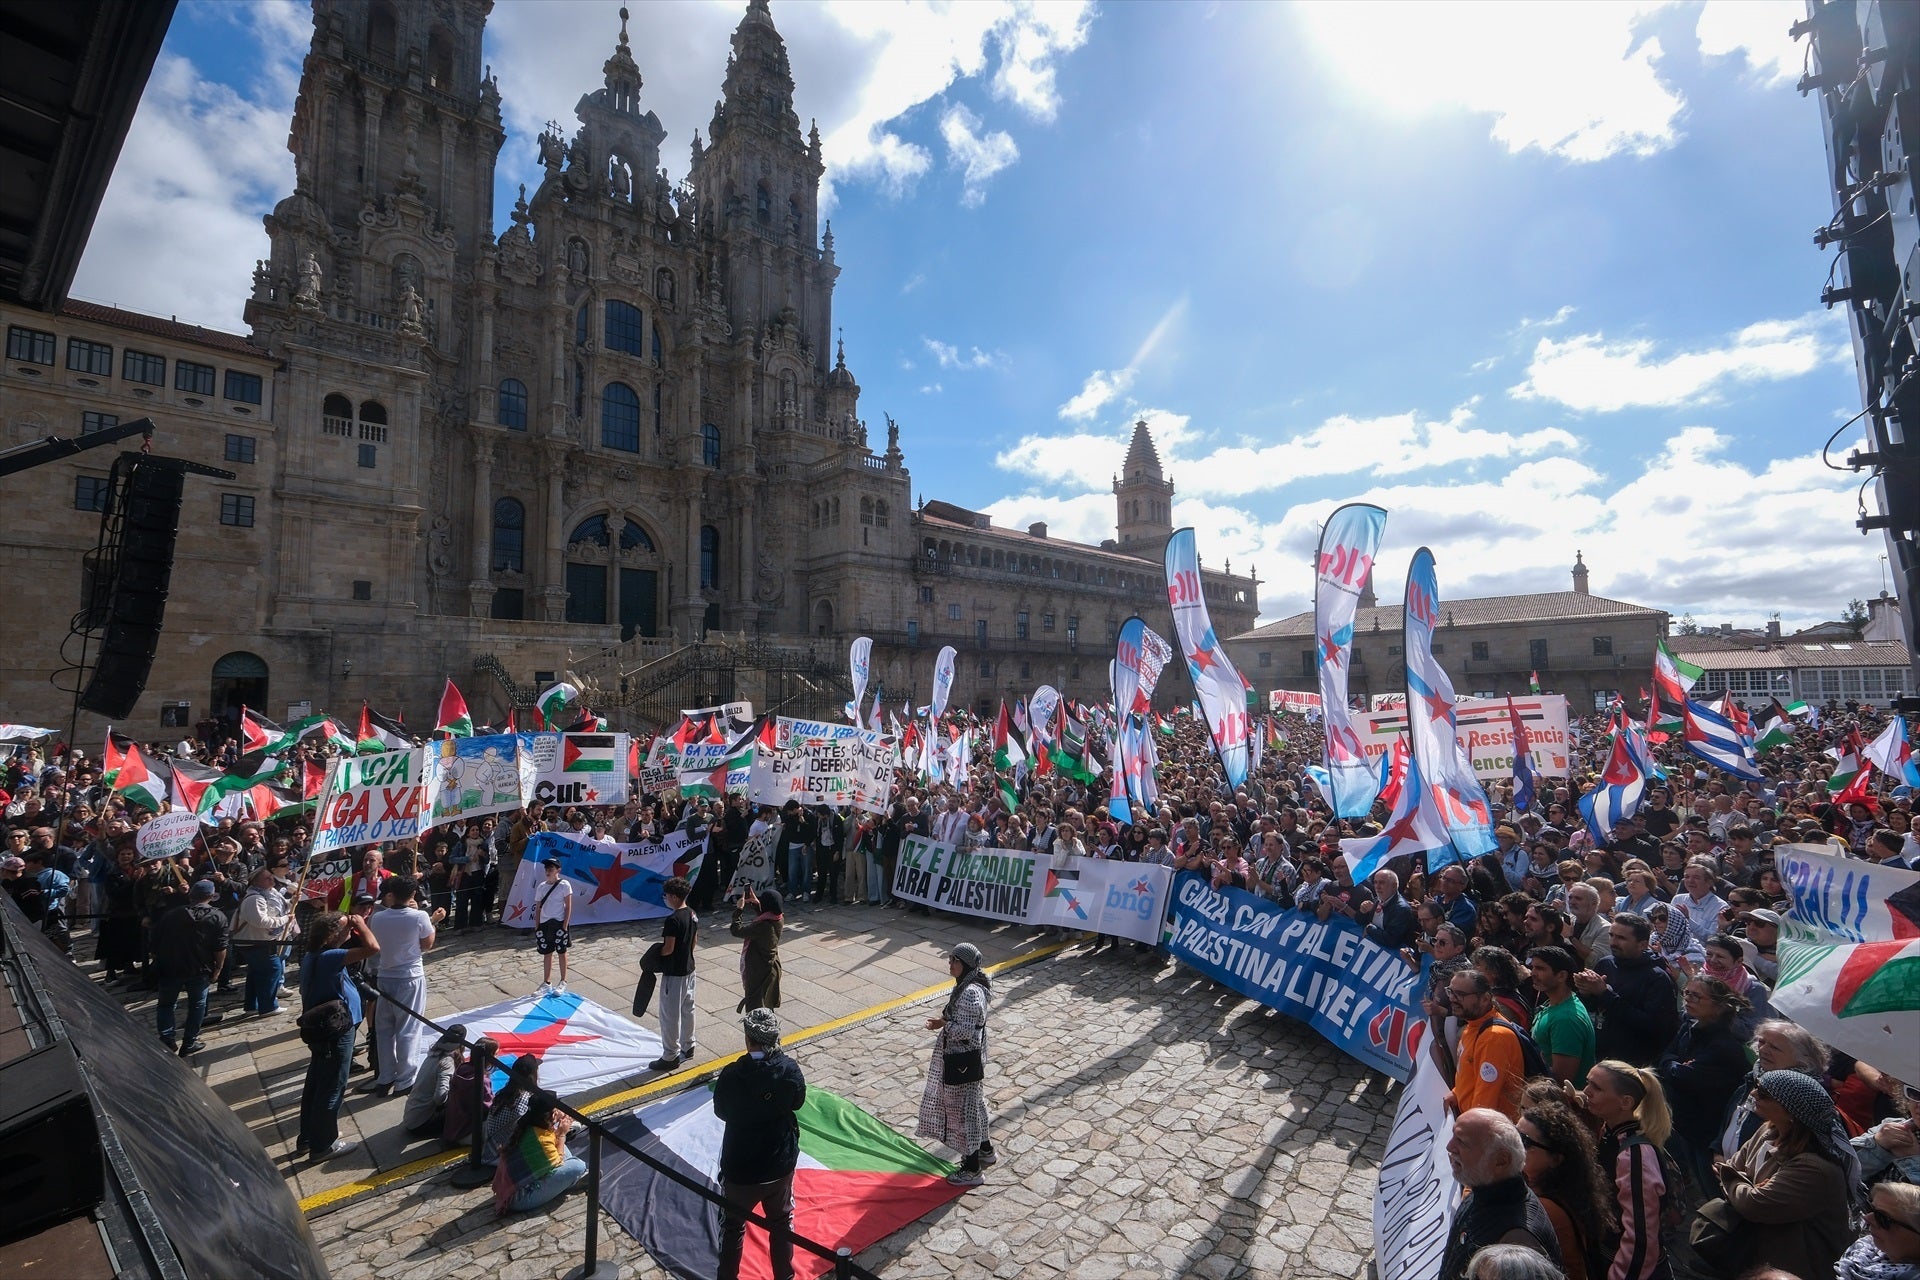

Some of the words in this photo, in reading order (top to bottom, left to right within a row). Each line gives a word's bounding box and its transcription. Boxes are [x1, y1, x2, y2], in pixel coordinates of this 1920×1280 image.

[793, 721, 828, 736] FOLGA
[1364, 743, 1387, 756] om
[773, 761, 792, 773] EN
[811, 758, 858, 772] DEFENSA
[875, 766, 889, 782] DE
[790, 776, 848, 792] PALESTINA
[319, 789, 370, 833] LGA
[370, 820, 382, 839] O
[627, 842, 672, 857] PALESTINA
[901, 839, 929, 869] AZ
[928, 847, 944, 874] E
[945, 850, 1036, 888] LIBERDADE
[895, 864, 932, 899] ARA
[934, 875, 1031, 918] PALESTINA!
[1106, 884, 1155, 921] bng
[1180, 878, 1230, 926] GALIZA
[1177, 918, 1287, 994] PALESTINA
